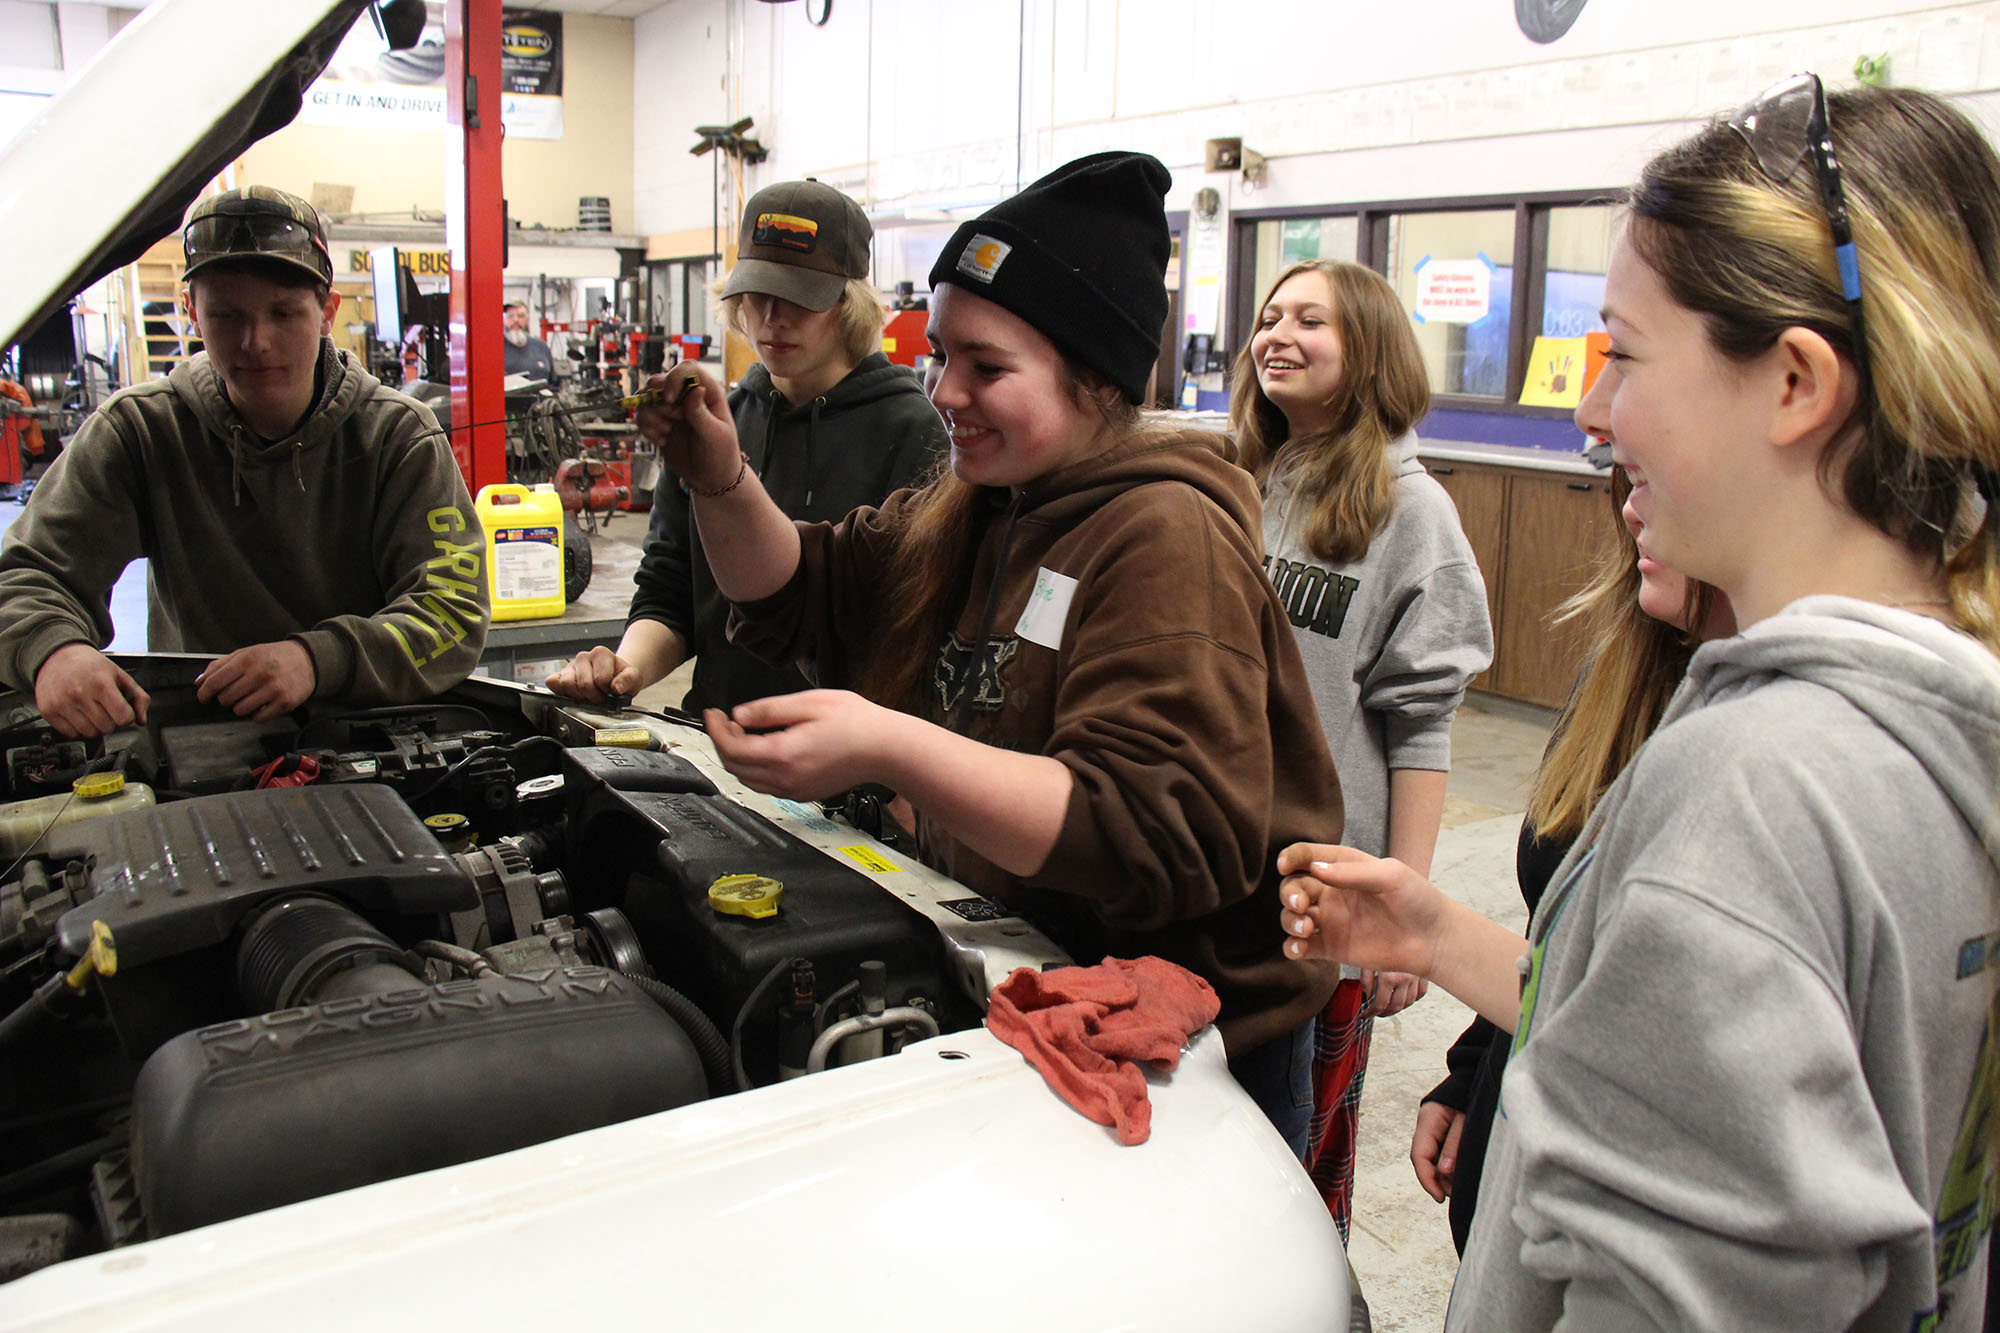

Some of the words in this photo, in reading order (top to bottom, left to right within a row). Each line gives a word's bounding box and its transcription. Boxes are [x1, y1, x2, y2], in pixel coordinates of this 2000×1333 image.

[313, 90, 343, 105] GET
[346, 94, 361, 107] IN
[368, 95, 398, 110] AND
[419, 251, 450, 274] BUS
[206, 977, 625, 1066] MAGNUM
